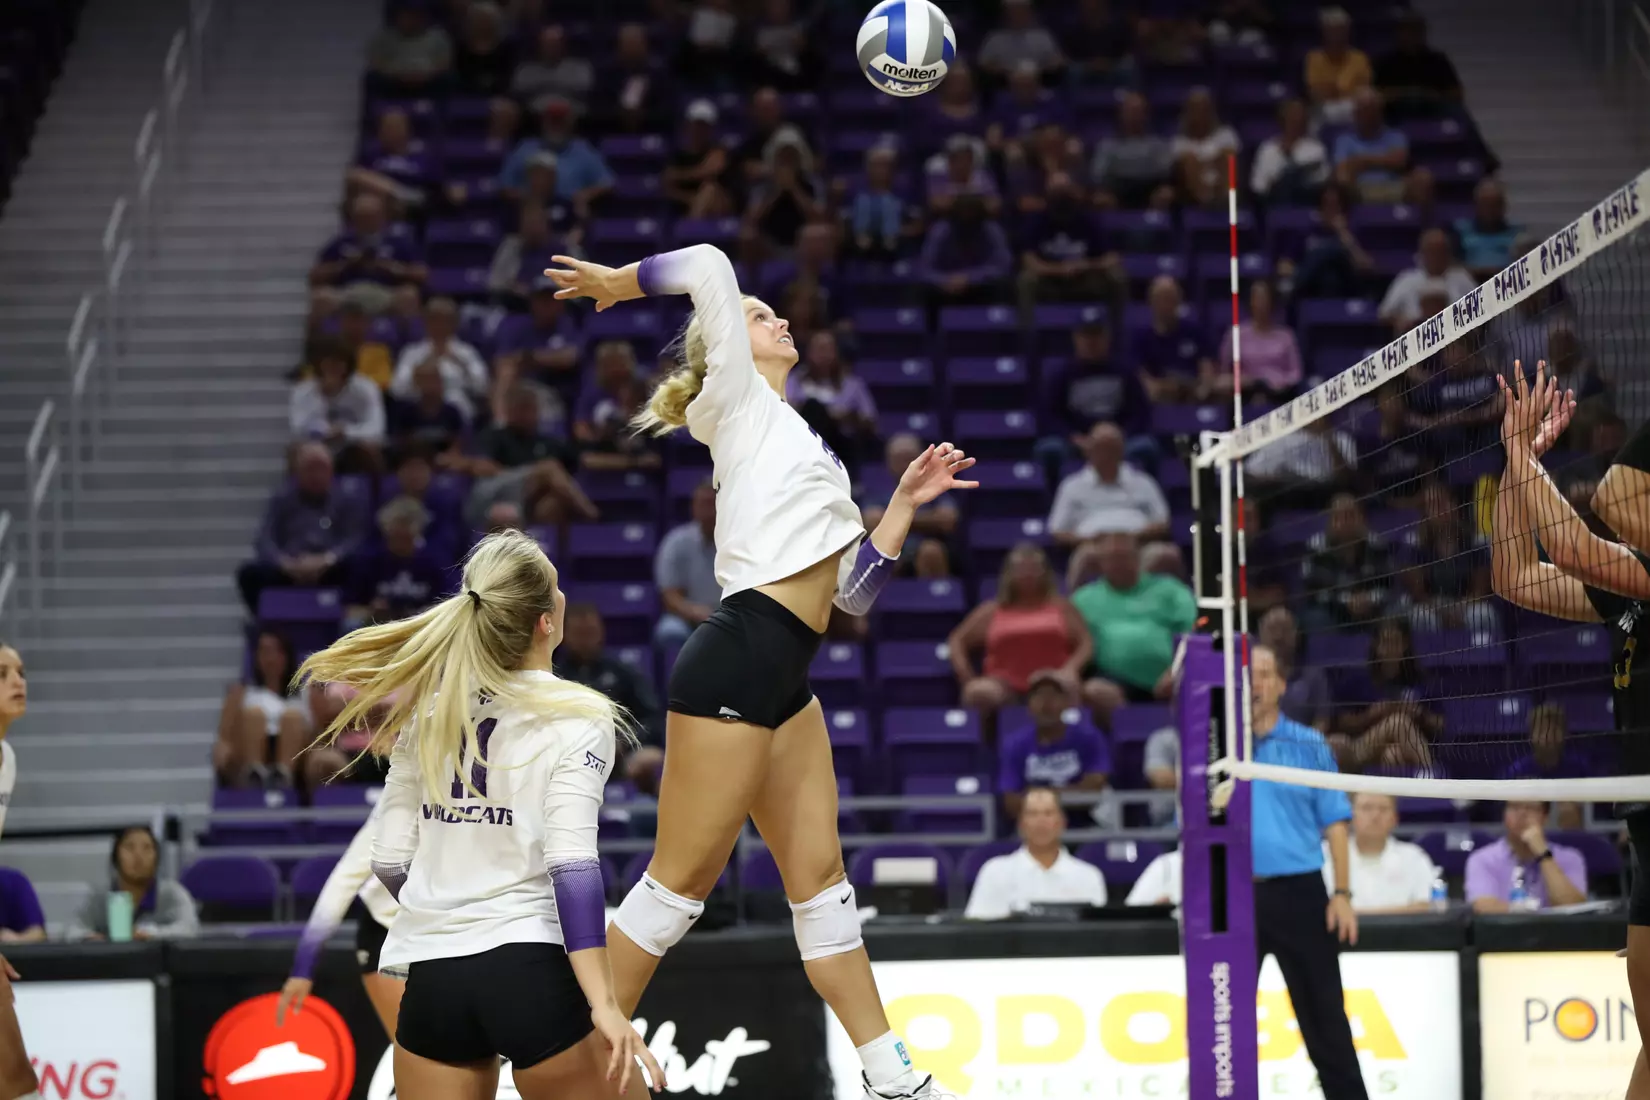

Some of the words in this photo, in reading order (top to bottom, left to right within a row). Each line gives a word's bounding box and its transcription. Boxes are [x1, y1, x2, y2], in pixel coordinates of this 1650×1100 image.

[884, 63, 937, 79] molten
[884, 79, 930, 92] NCAA
[422, 803, 513, 826] WILDCATS
[1209, 961, 1233, 1023] sports
[885, 989, 1408, 1092] QDOBA
[31, 1057, 120, 1100] NG
[996, 1072, 1188, 1097] MEXIC
